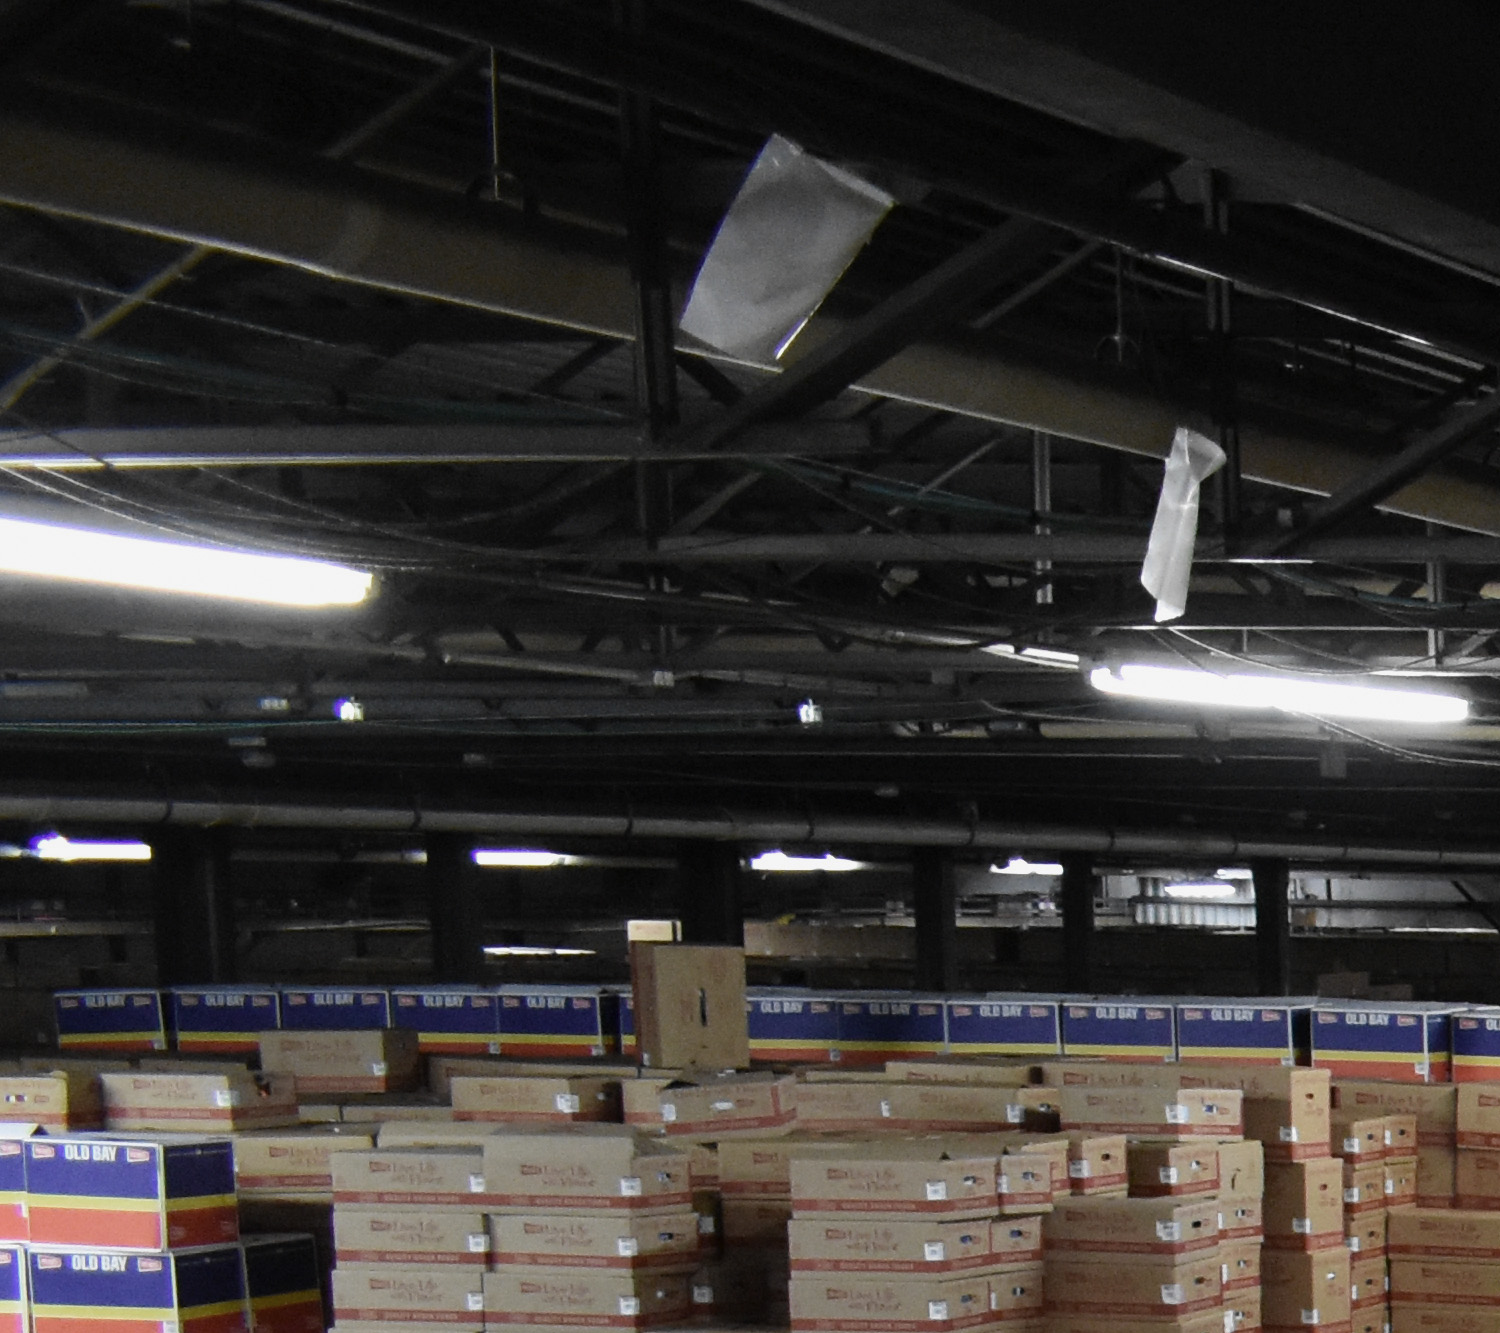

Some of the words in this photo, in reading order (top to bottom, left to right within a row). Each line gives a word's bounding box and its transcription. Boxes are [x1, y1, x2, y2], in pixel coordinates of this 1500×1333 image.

[86, 996, 104, 1008] OLD
[107, 995, 125, 1008] BAY
[980, 1006, 999, 1017] OLD
[1002, 1006, 1021, 1017] BAY
[1346, 1014, 1364, 1025] OLD
[1368, 1014, 1389, 1026] BAY
[65, 1145, 90, 1160] OLD
[93, 1146, 116, 1161] BAY
[71, 1255, 97, 1270] OLD
[101, 1256, 127, 1271] BAY
